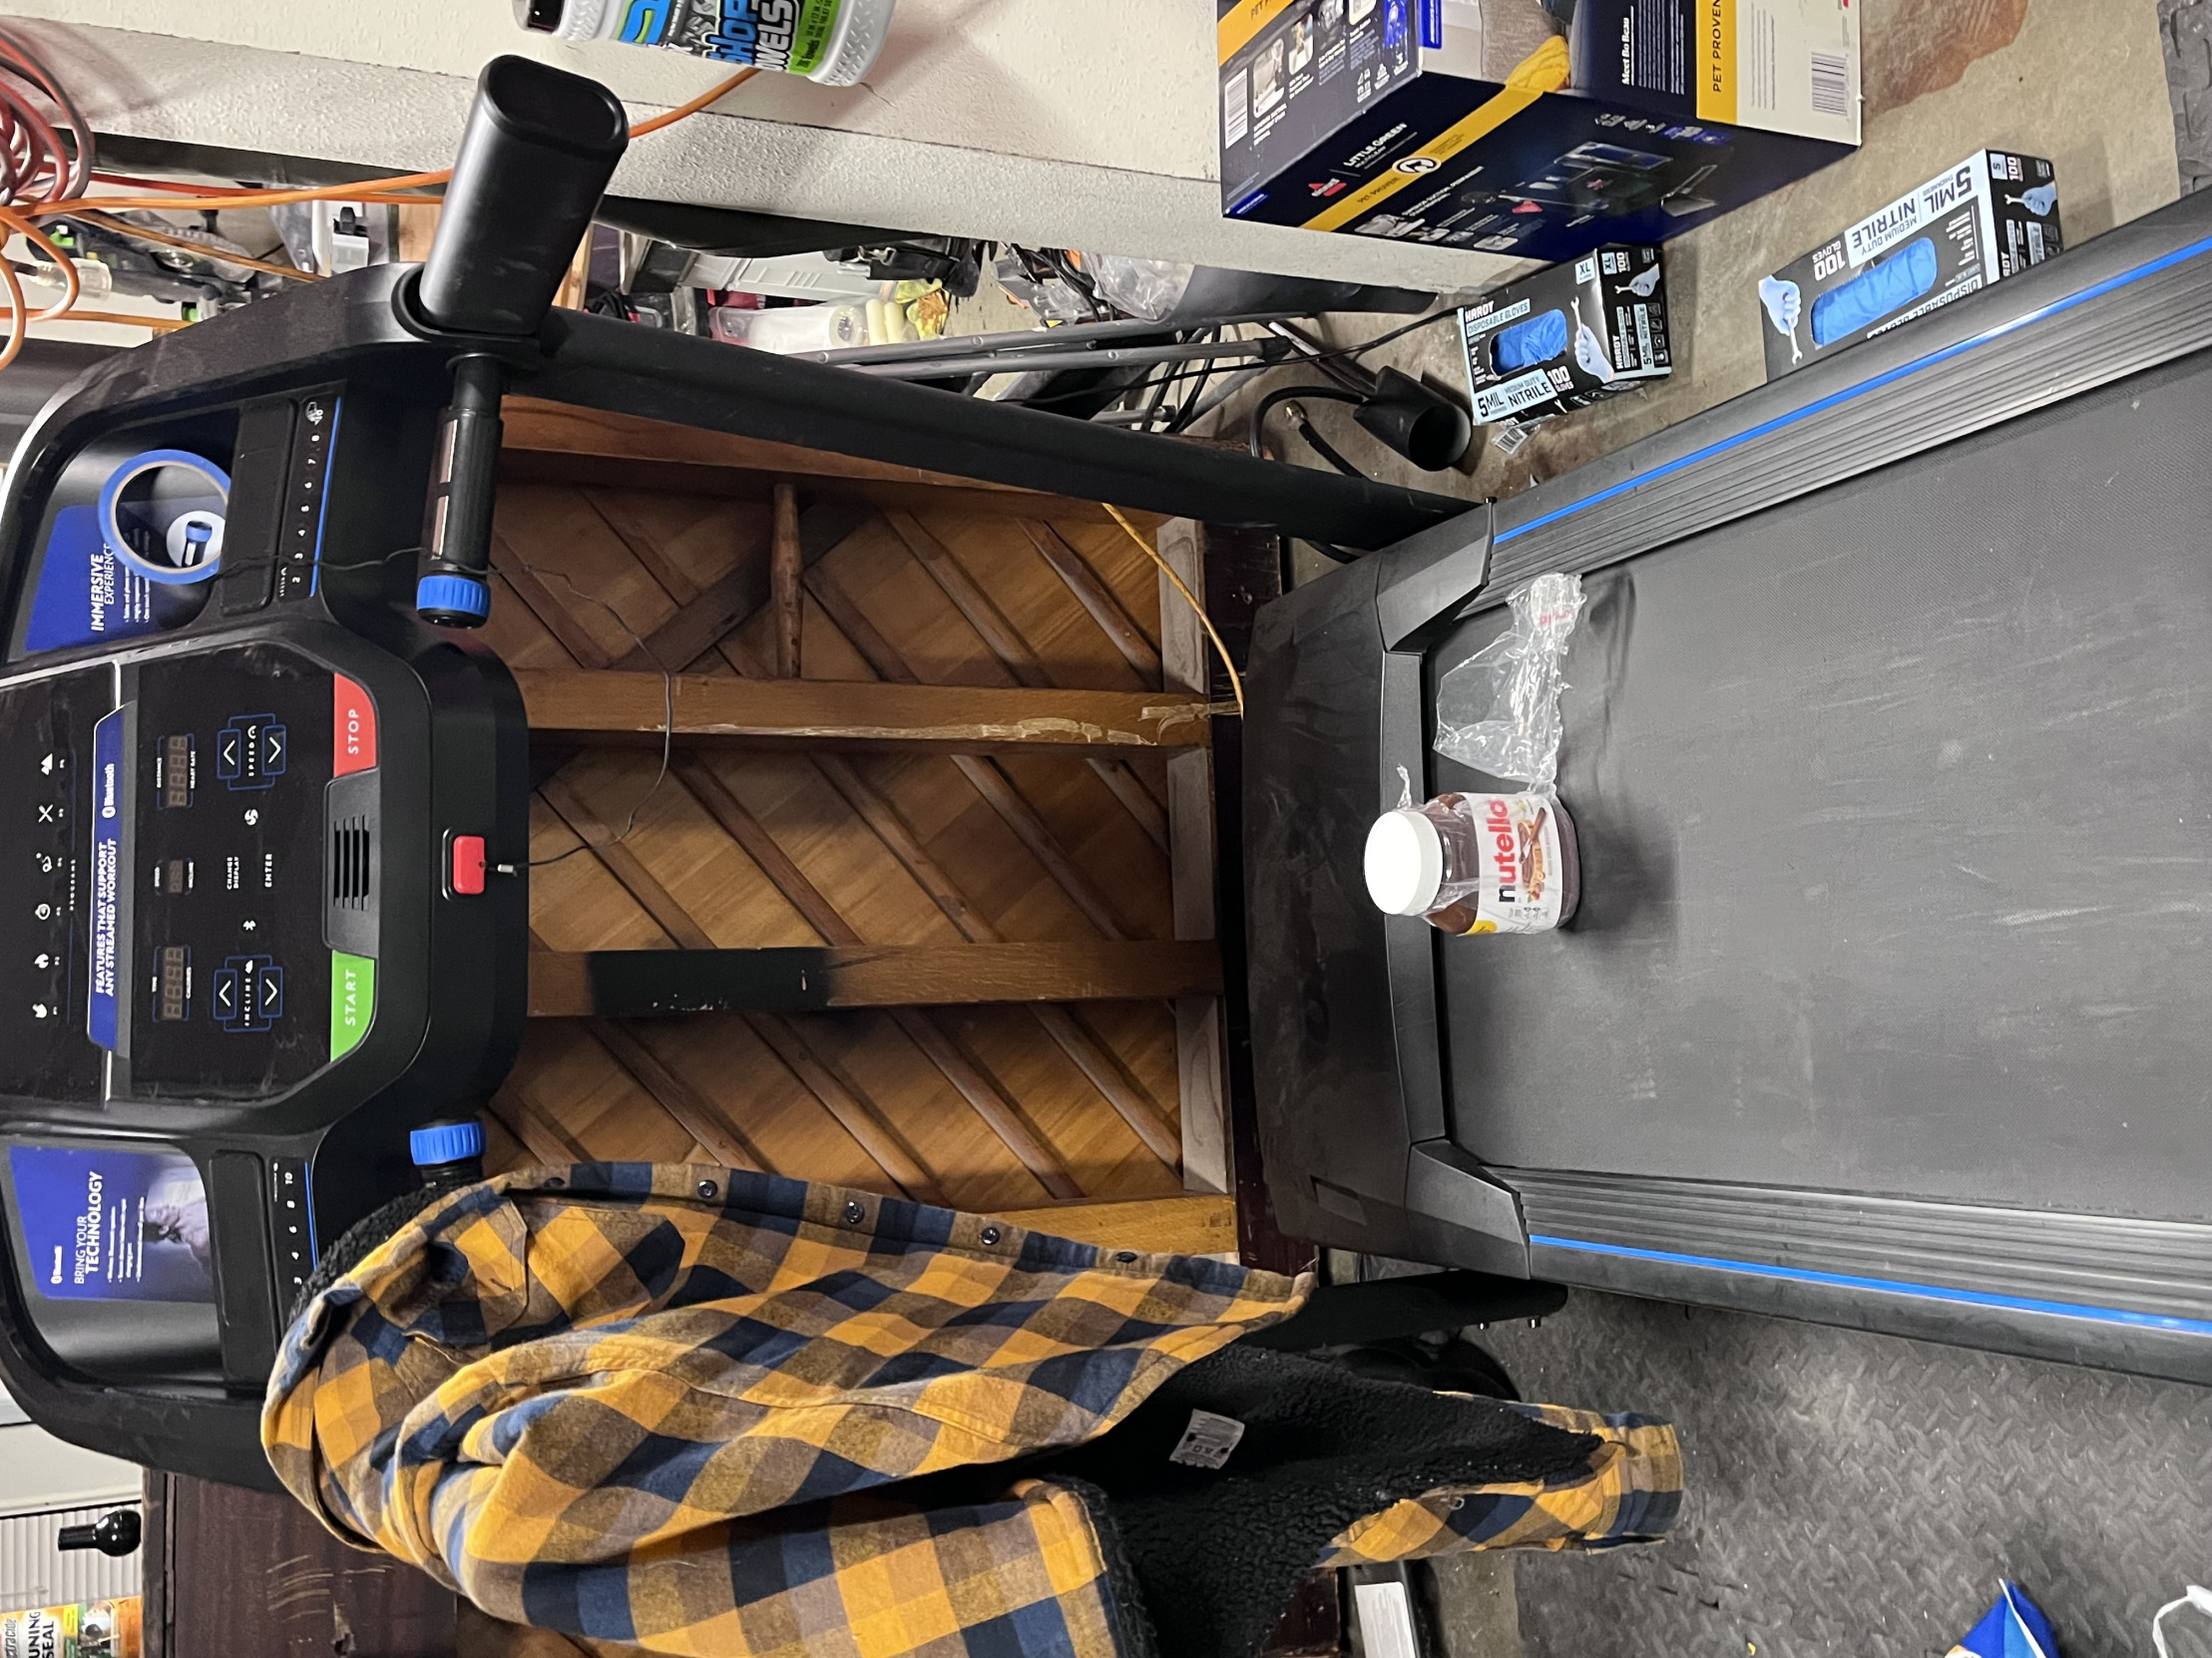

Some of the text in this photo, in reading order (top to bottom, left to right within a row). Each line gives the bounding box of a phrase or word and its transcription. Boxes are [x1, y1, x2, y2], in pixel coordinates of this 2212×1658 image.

[1621, 17, 1630, 85] Meet Bo Beau
[1712, 0, 1722, 93] PET PROVEN
[1343, 145, 1377, 167] LITTLE
[1372, 122, 1407, 147] GREEN
[1956, 166, 1972, 199] 5
[2006, 157, 2018, 181] 100
[1924, 183, 1955, 214] MIL
[1851, 198, 1916, 248] NITRILE
[1861, 215, 1917, 255] MEDIUM DUTY
[1578, 262, 1591, 275] XL
[1603, 257, 1611, 269] XL
[1616, 251, 1626, 273] 100
[1812, 239, 1841, 263] GLOVES
[1814, 251, 1846, 281] 100
[1465, 300, 1495, 323] HARDY
[1468, 302, 1529, 334] DISPOSABLE GLOVES
[1639, 307, 1648, 339] NITRILE
[1612, 334, 1624, 369] HARDY
[1547, 365, 1570, 385] 100
[1478, 396, 1489, 418] 5
[1485, 392, 1505, 410] MIL
[1508, 382, 1552, 408] NITRILE
[90, 554, 105, 631] IMMERSIVE
[347, 708, 359, 755] STOP
[103, 763, 115, 806] Bluetooth
[1486, 799, 1517, 903] nutella
[264, 853, 273, 888] ENTER
[96, 842, 108, 994] FEATURES THAT SUPPORT
[105, 838, 117, 997] ANY STREAMED WORKOUT
[344, 969, 356, 1027] START
[284, 1172, 293, 1184] 10
[85, 1171, 103, 1274] TECHNOLOGY
[74, 1215, 88, 1284] BRING YOUR
[42, 1621, 54, 1658] SEAL
